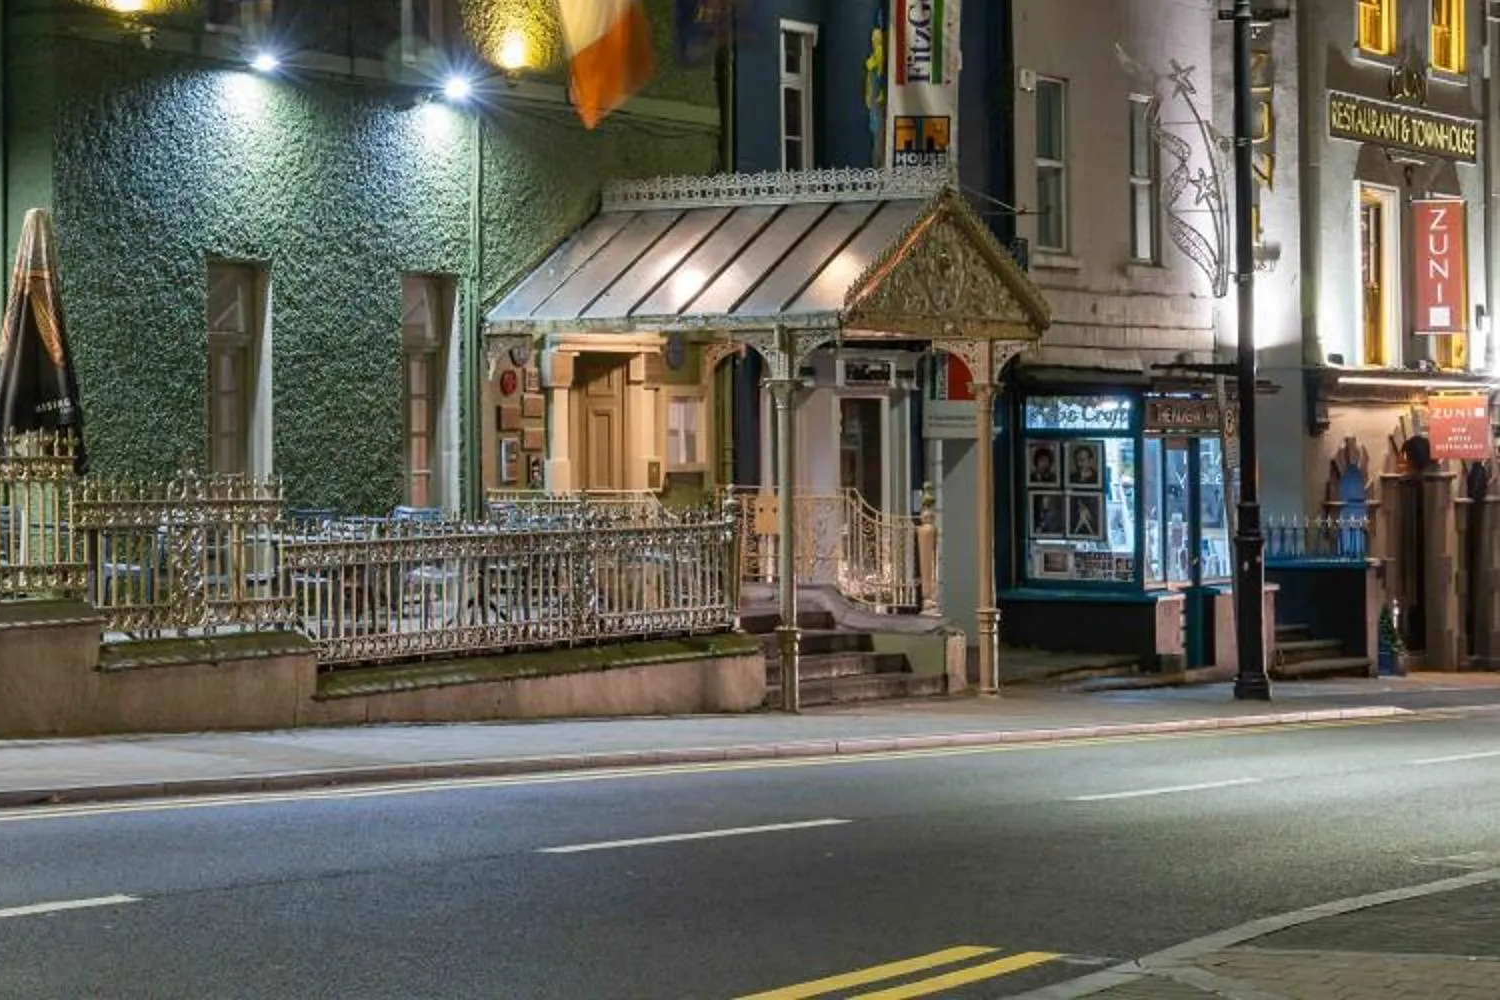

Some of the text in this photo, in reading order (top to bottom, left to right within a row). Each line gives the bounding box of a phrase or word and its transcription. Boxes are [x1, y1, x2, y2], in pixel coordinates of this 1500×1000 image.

[1330, 99, 1475, 155] RESTAURANT & TOWNHOUSE
[1429, 208, 1449, 303] ZUNI
[1432, 407, 1473, 419] ZUNI
